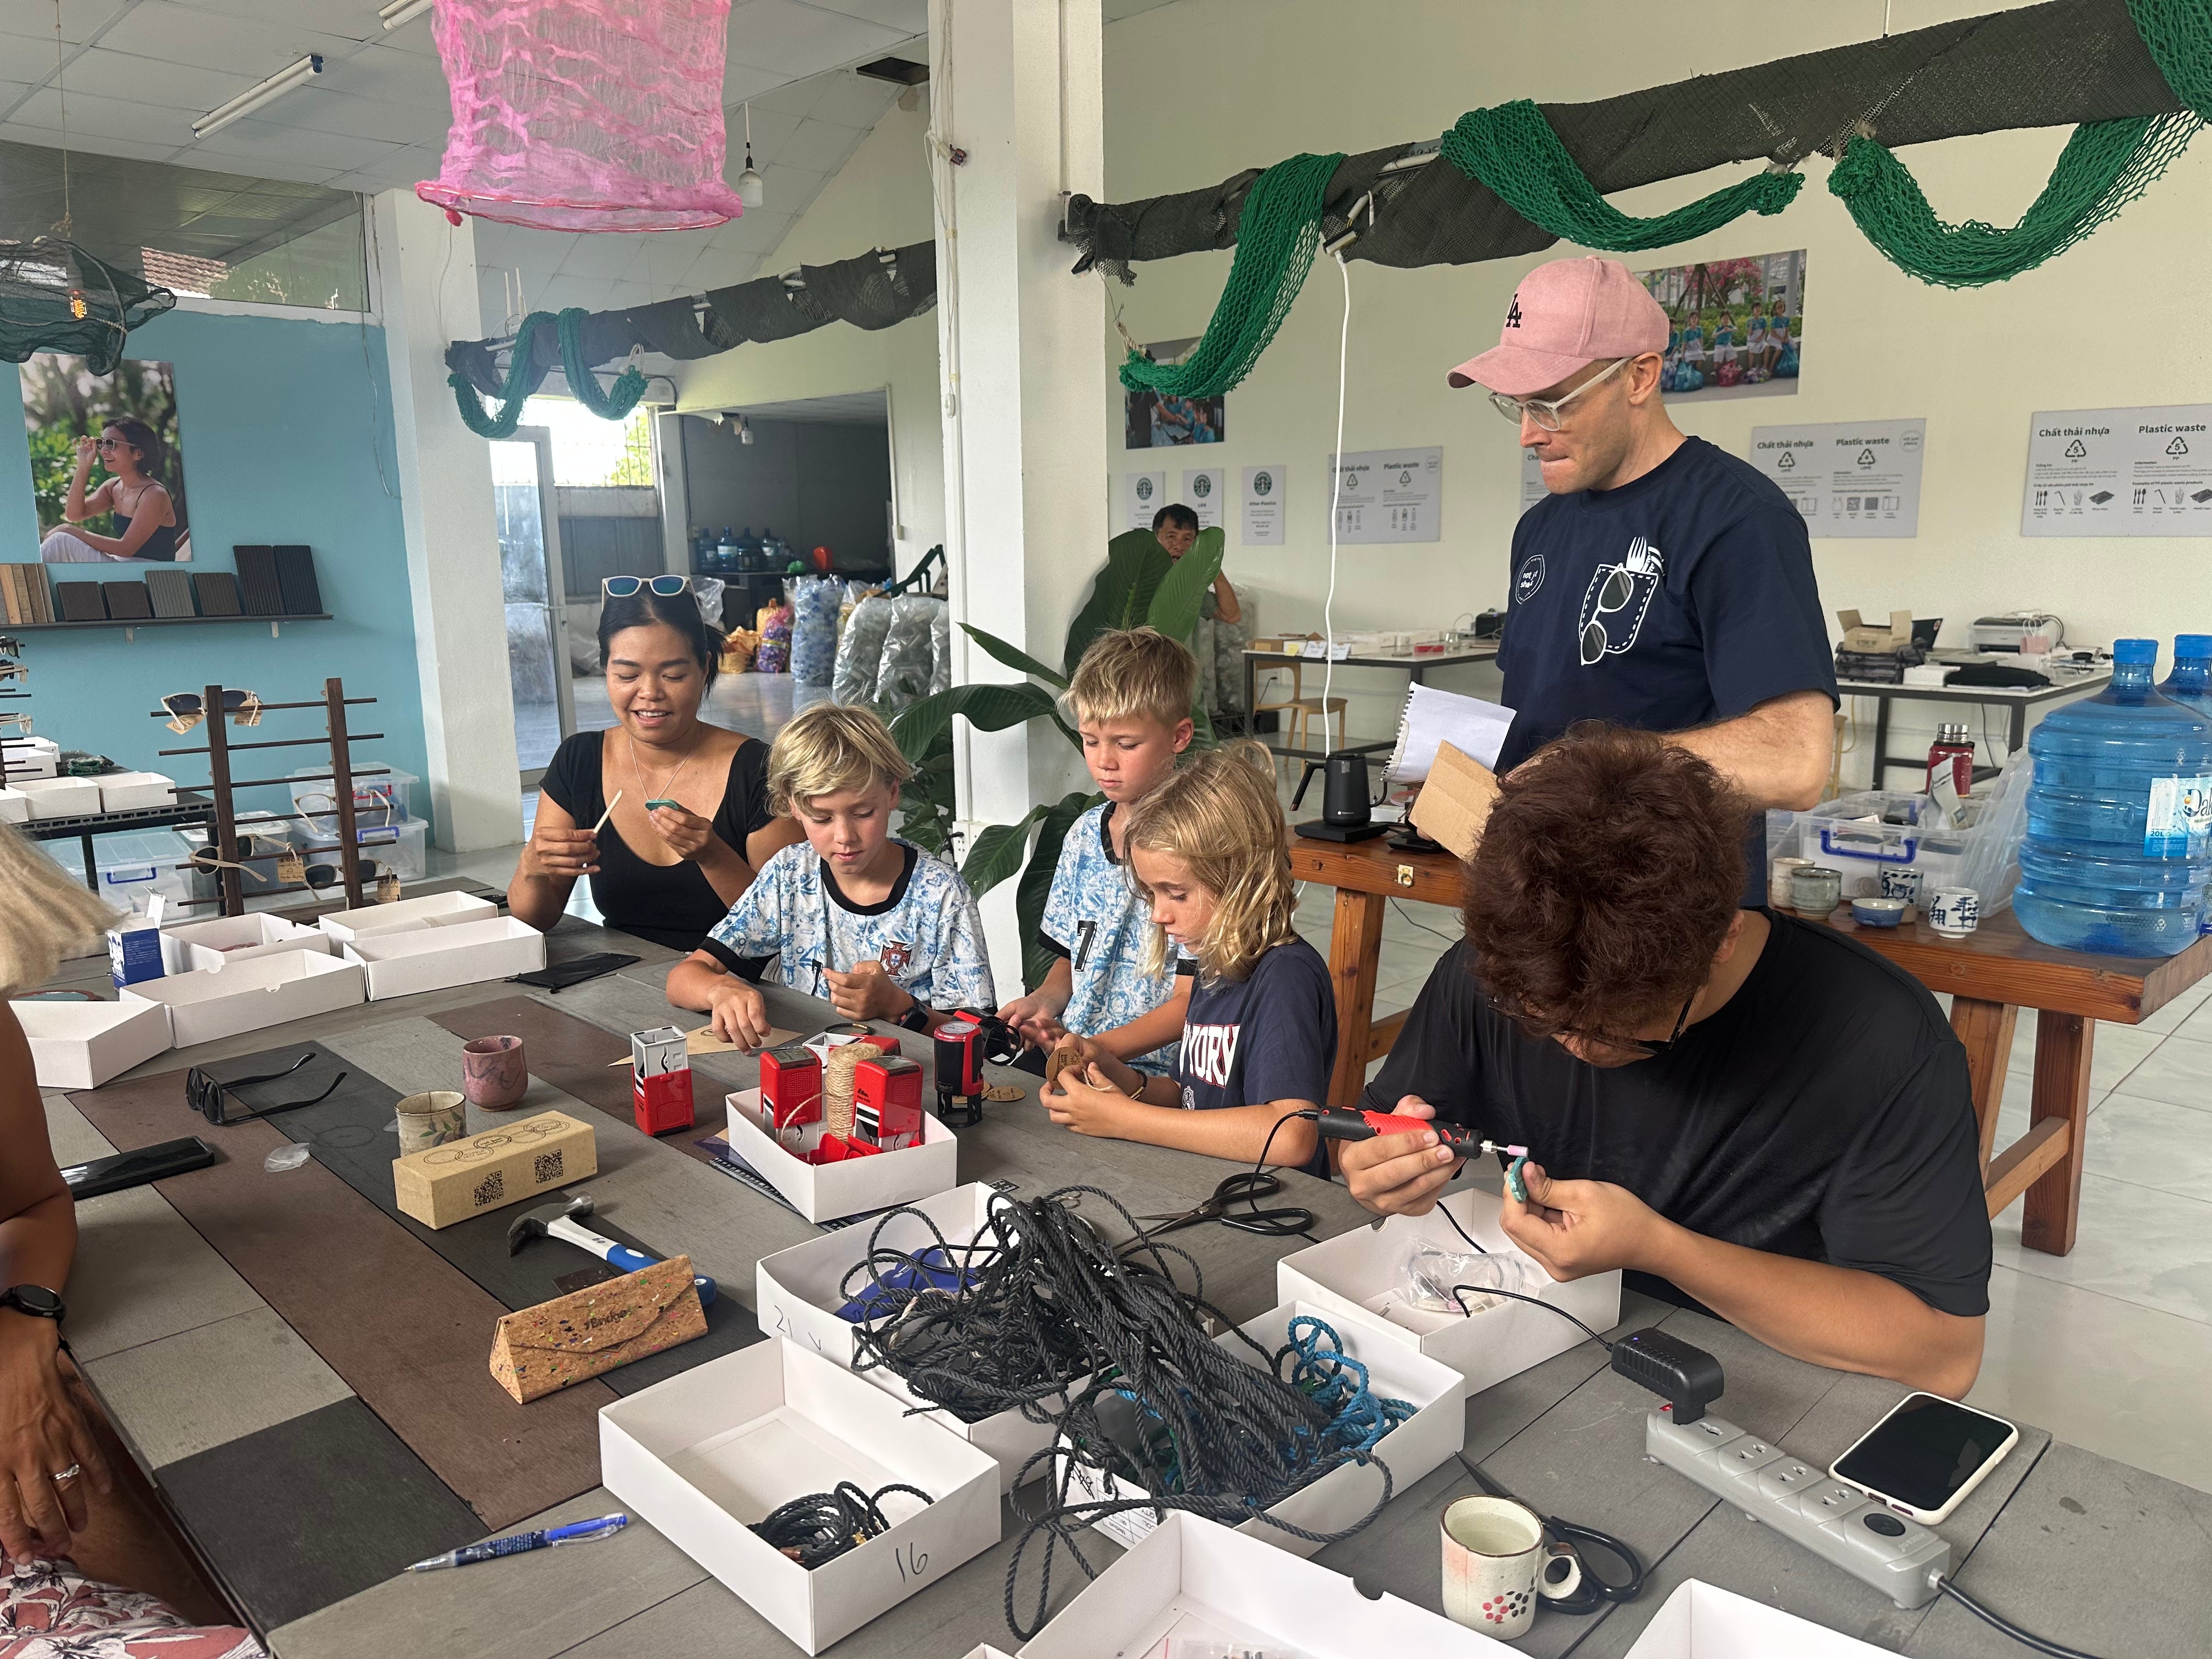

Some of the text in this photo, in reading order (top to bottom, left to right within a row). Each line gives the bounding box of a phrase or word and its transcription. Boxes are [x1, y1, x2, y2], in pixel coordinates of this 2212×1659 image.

[1506, 293, 1522, 329] LA
[1836, 438, 1863, 447] Plastic
[2039, 427, 2109, 437] Chất thải nhựa
[2138, 424, 2207, 433] Plastic waste
[2182, 788, 2212, 817] Da
[1074, 919, 1098, 972] 7
[811, 958, 824, 997] 7
[774, 1304, 793, 1339] 21
[896, 1542, 928, 1584] 16
